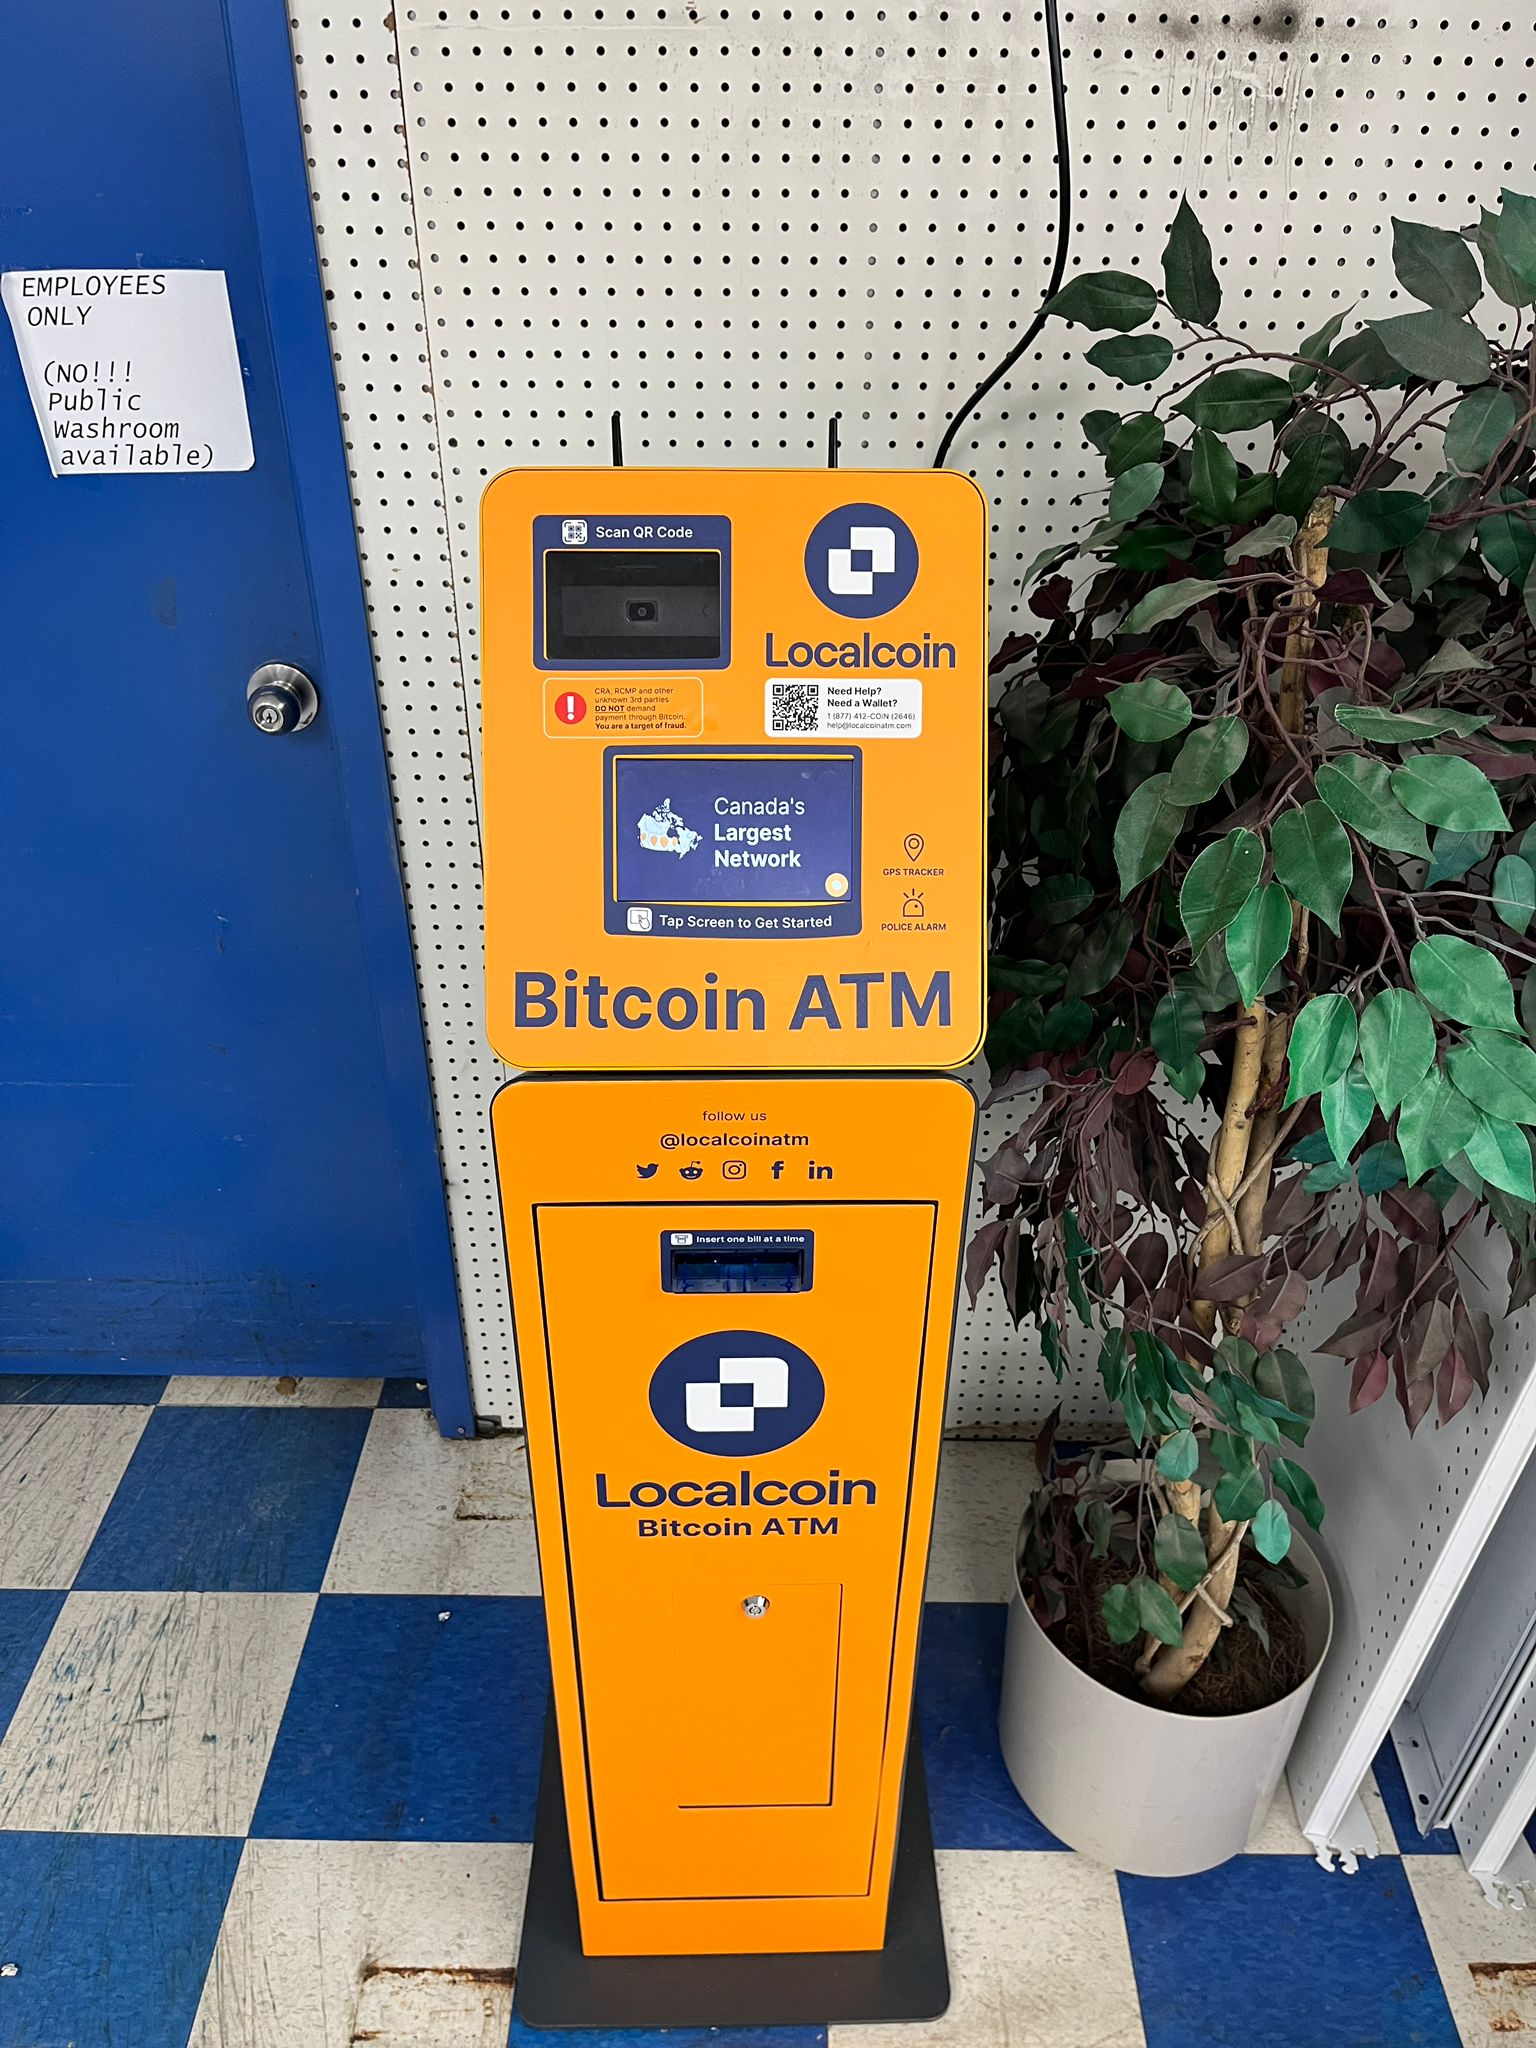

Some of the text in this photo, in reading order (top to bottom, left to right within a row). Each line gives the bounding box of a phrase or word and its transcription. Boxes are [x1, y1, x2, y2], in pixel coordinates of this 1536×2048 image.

[22, 274, 166, 297] EMPLOYEES
[27, 306, 92, 326] ONLY
[44, 361, 131, 386] (NO!!!
[49, 388, 141, 411] Public
[54, 416, 180, 439] Washroom
[61, 444, 213, 468] available)
[595, 526, 693, 539] Scan QR Code
[766, 632, 956, 669] Localcoin
[644, 696, 669, 704] parties
[827, 687, 882, 697] Need Help?
[827, 699, 852, 707] Need
[862, 699, 898, 707] Wallet?
[595, 714, 626, 722] payment
[827, 722, 912, 730] help@localcoinatm.com
[714, 797, 805, 816] Canada's
[714, 823, 792, 846] Largest
[714, 849, 802, 868] Network
[883, 868, 944, 876] GPS TRACKER
[659, 914, 832, 929] Tap Screen to Get Started
[881, 923, 946, 931] POLICE ALARM
[514, 968, 951, 1031] Bitcoin ATM
[702, 1111, 767, 1121] follow us
[660, 1133, 809, 1149] @localcoinatm
[748, 1235, 761, 1243] bill
[783, 1235, 805, 1243] time
[595, 1469, 876, 1508] Localcoin
[638, 1517, 838, 1537] Bitcoin ATM
